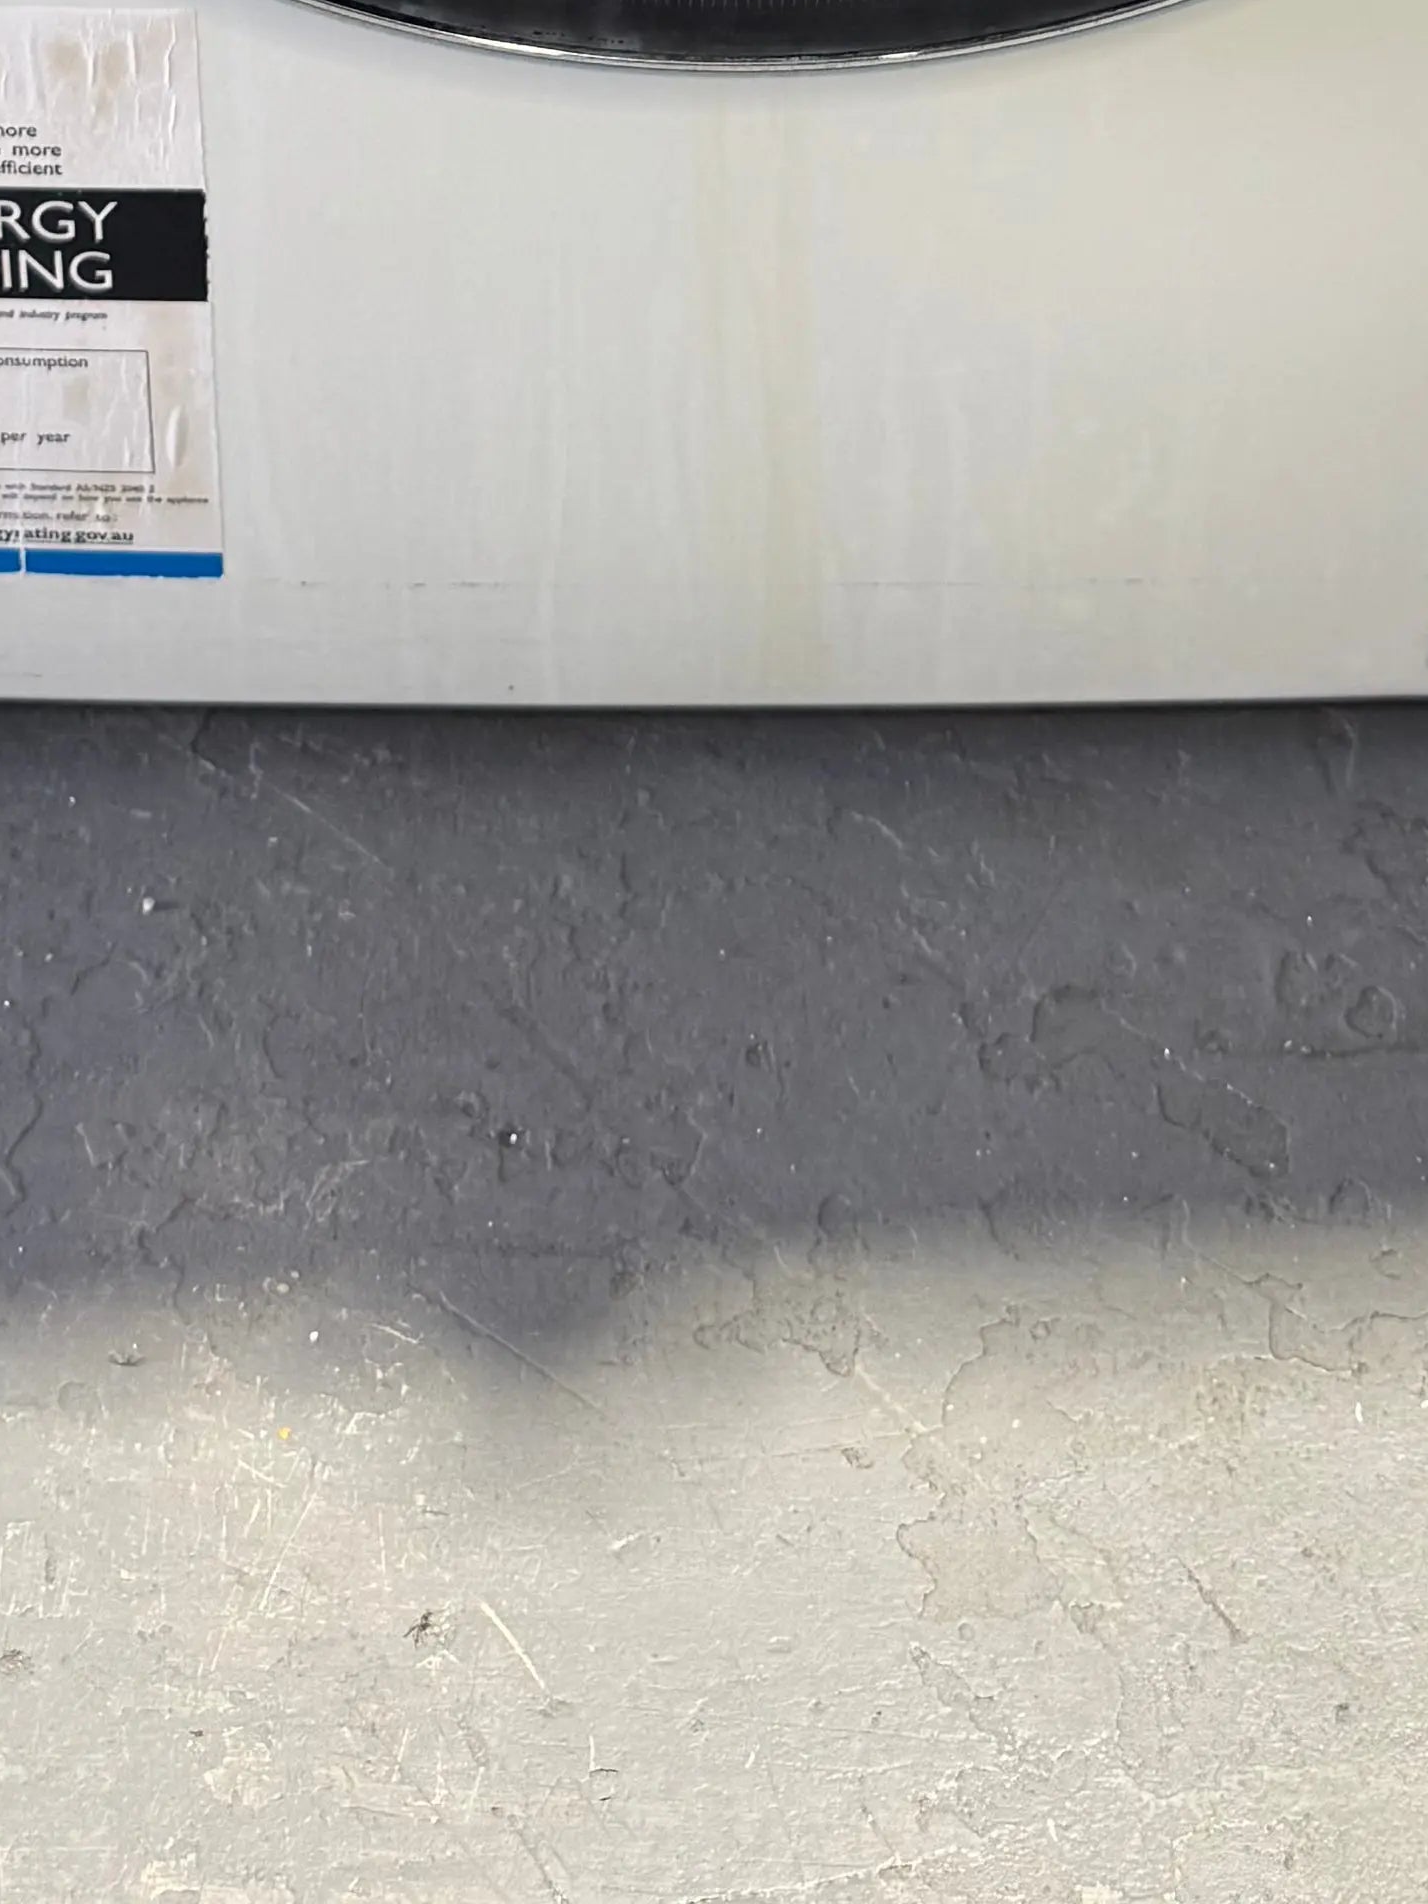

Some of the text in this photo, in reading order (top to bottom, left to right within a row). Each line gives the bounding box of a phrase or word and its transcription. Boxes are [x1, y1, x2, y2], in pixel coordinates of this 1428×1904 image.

[12, 145, 62, 158] more
[1, 430, 27, 445] per
[37, 431, 71, 445] year
